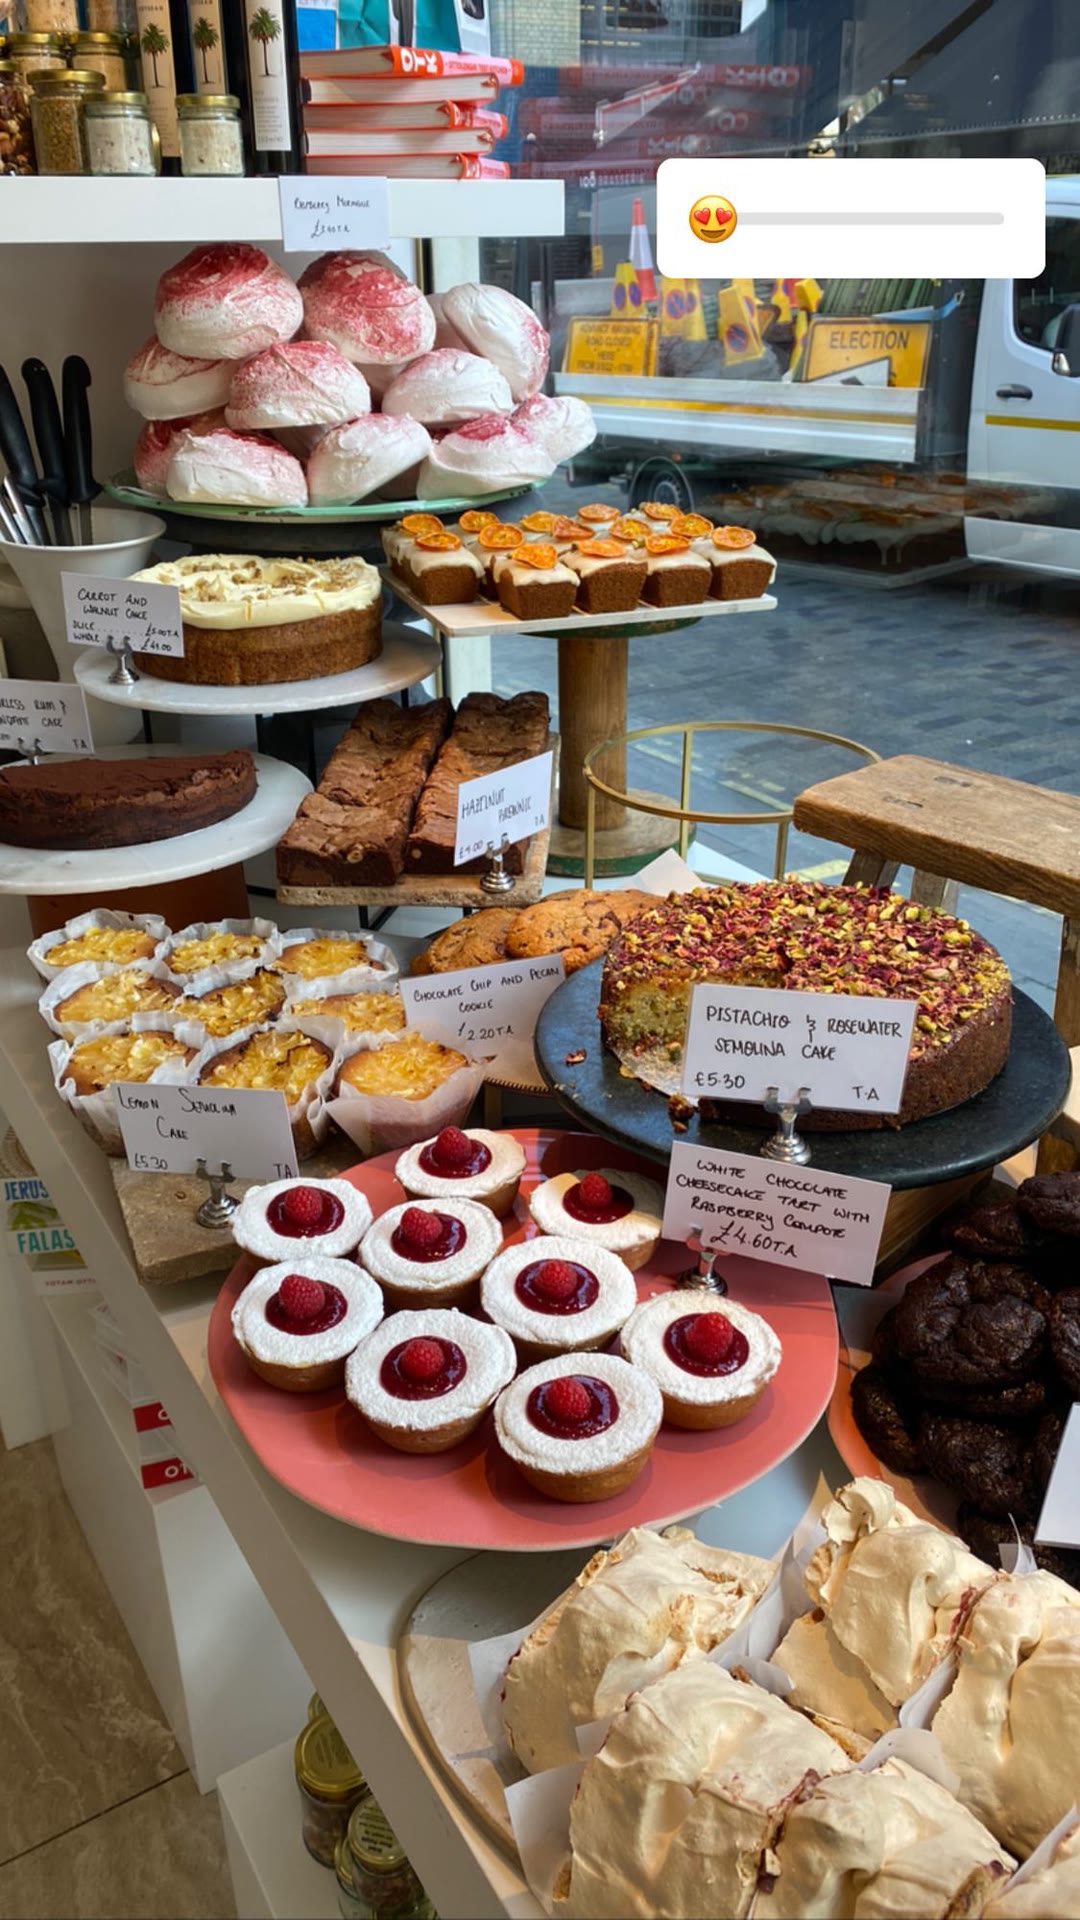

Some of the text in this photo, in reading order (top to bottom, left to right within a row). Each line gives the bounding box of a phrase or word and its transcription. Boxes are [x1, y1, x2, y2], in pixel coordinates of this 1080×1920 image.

[400, 48, 438, 73] OTK
[829, 330, 910, 350] ELECTION
[77, 587, 148, 607] CARROT AND
[83, 604, 148, 621] WALNUT CAKE
[41, 717, 63, 728] CAKE
[413, 967, 560, 1002] CHOCOLATE CHIP AND PECAN
[458, 999, 494, 1013] COOKIE
[706, 1005, 792, 1029] PISTACHIO
[827, 1018, 903, 1038] ROSEWATER
[715, 1037, 837, 1061] SEMOLINA CAKE
[117, 1086, 160, 1110] LEMON
[156, 1115, 190, 1140] CAKE
[697, 1159, 849, 1200] WHITE CHOCOLATE
[675, 1173, 870, 1223] CHEESECAKE TART WITH
[690, 1196, 847, 1239] RASPBERRY COMPOTE
